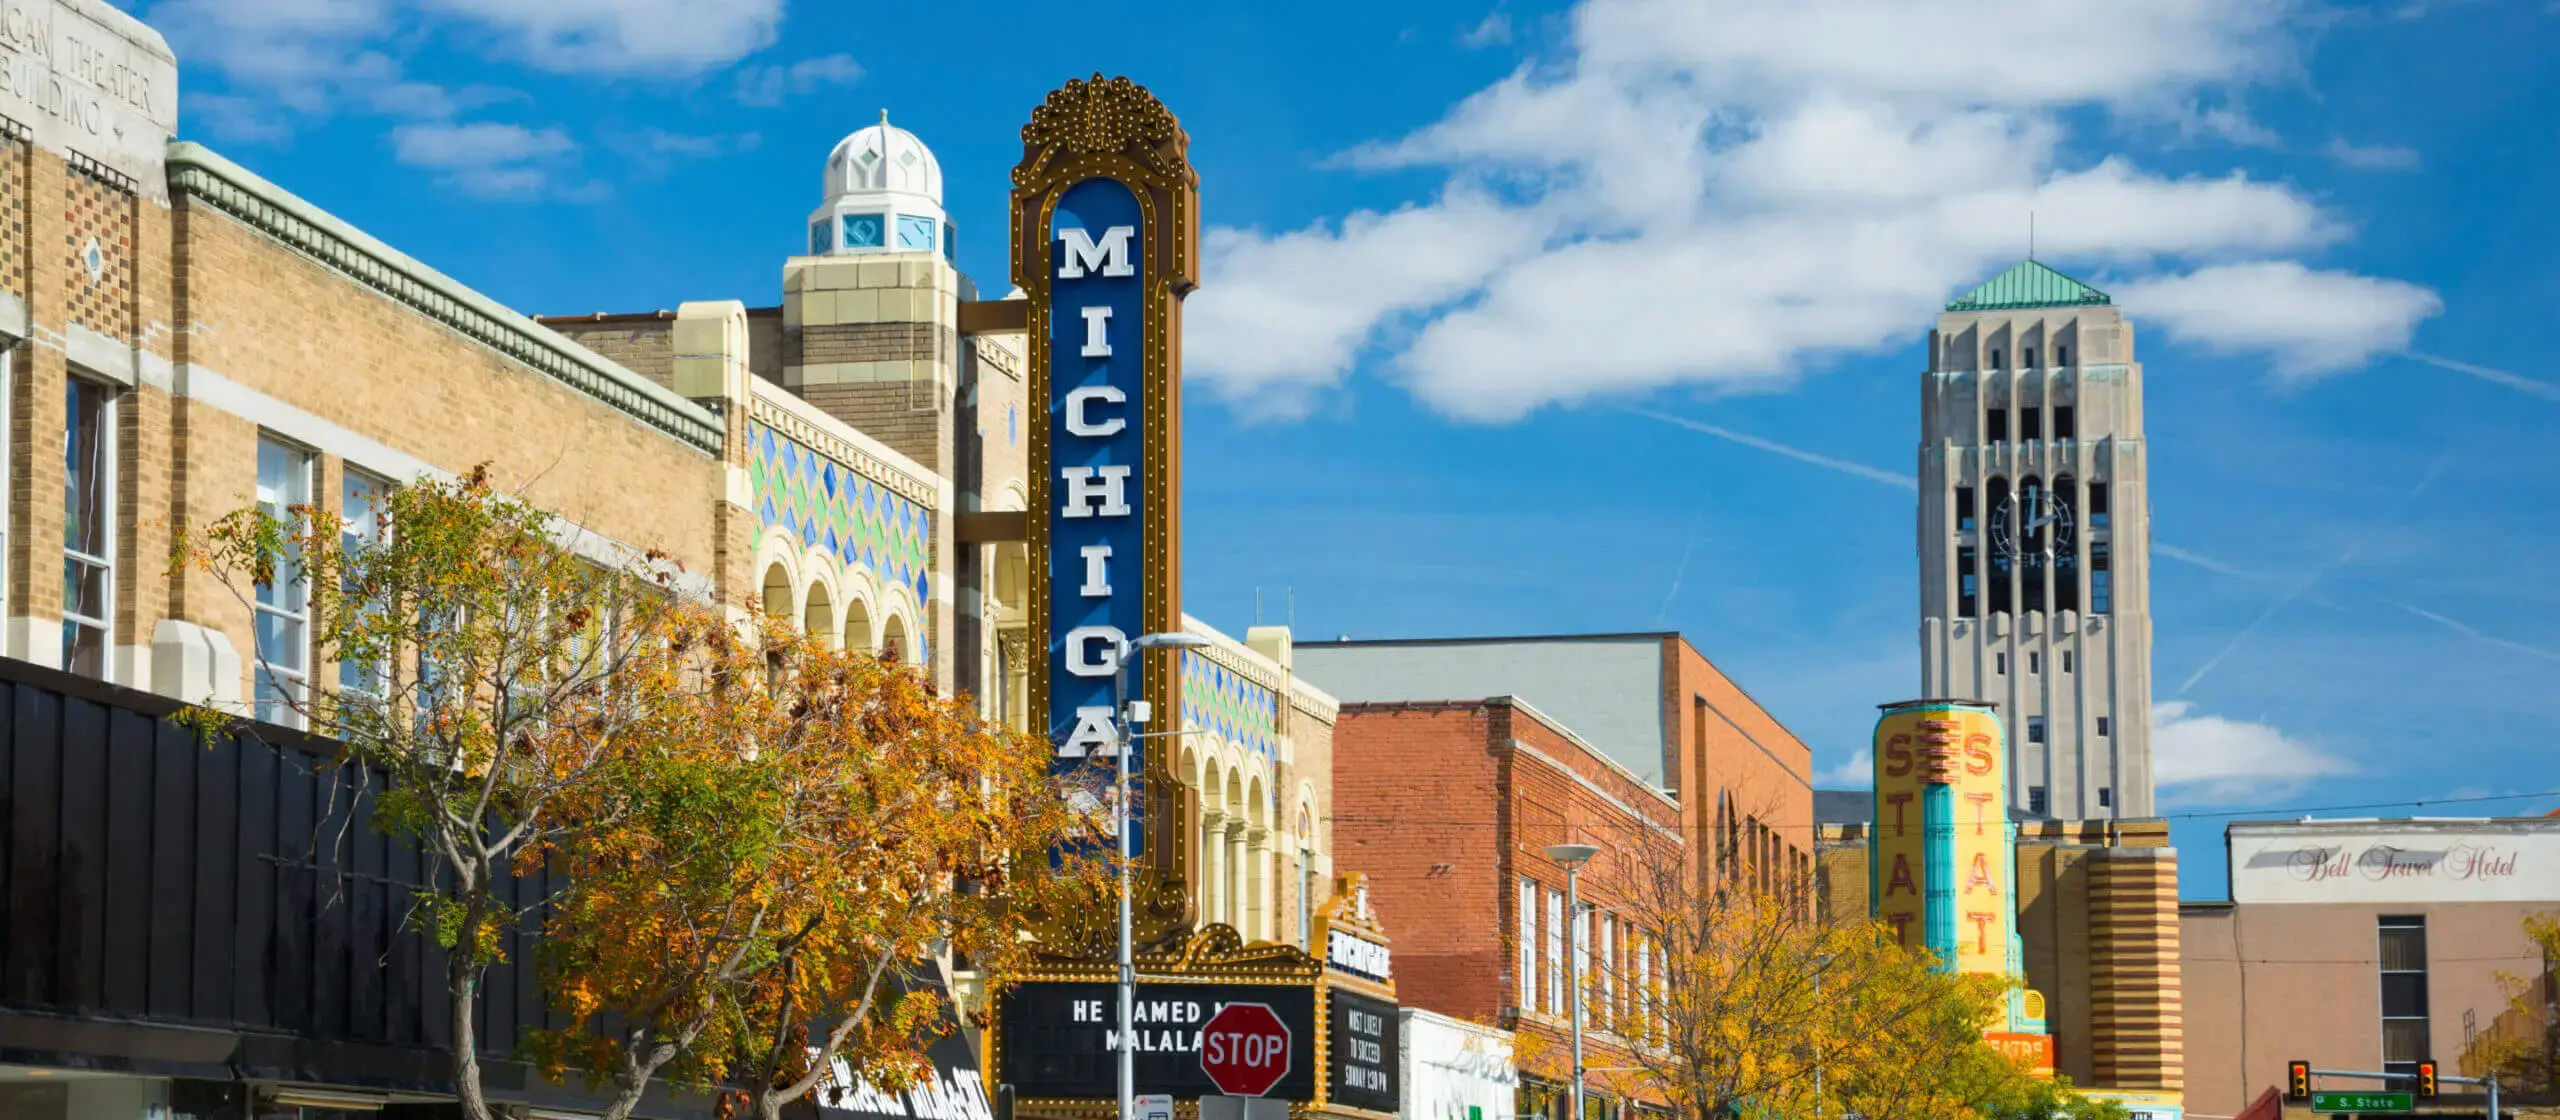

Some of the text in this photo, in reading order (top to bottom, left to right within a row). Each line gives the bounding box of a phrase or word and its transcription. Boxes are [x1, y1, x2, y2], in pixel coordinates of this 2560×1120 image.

[66, 36, 152, 113] THEATER
[0, 55, 100, 135] BUILDING
[1885, 733, 1916, 952] STAT
[1963, 732, 1997, 978] STAT
[2287, 844, 2518, 881] Bell Tower Hotel
[1073, 1000, 1103, 1022] HE
[1117, 1001, 1201, 1023] AMED
[1348, 1009, 1382, 1037] MOST LIKELY
[1106, 1029, 1204, 1052] MALALA
[1207, 1032, 1283, 1068] STOP
[1350, 1036, 1380, 1064] TO SUCCEED
[1345, 1064, 1366, 1088] SUNDAY
[2339, 1097, 2394, 1108] S. State
